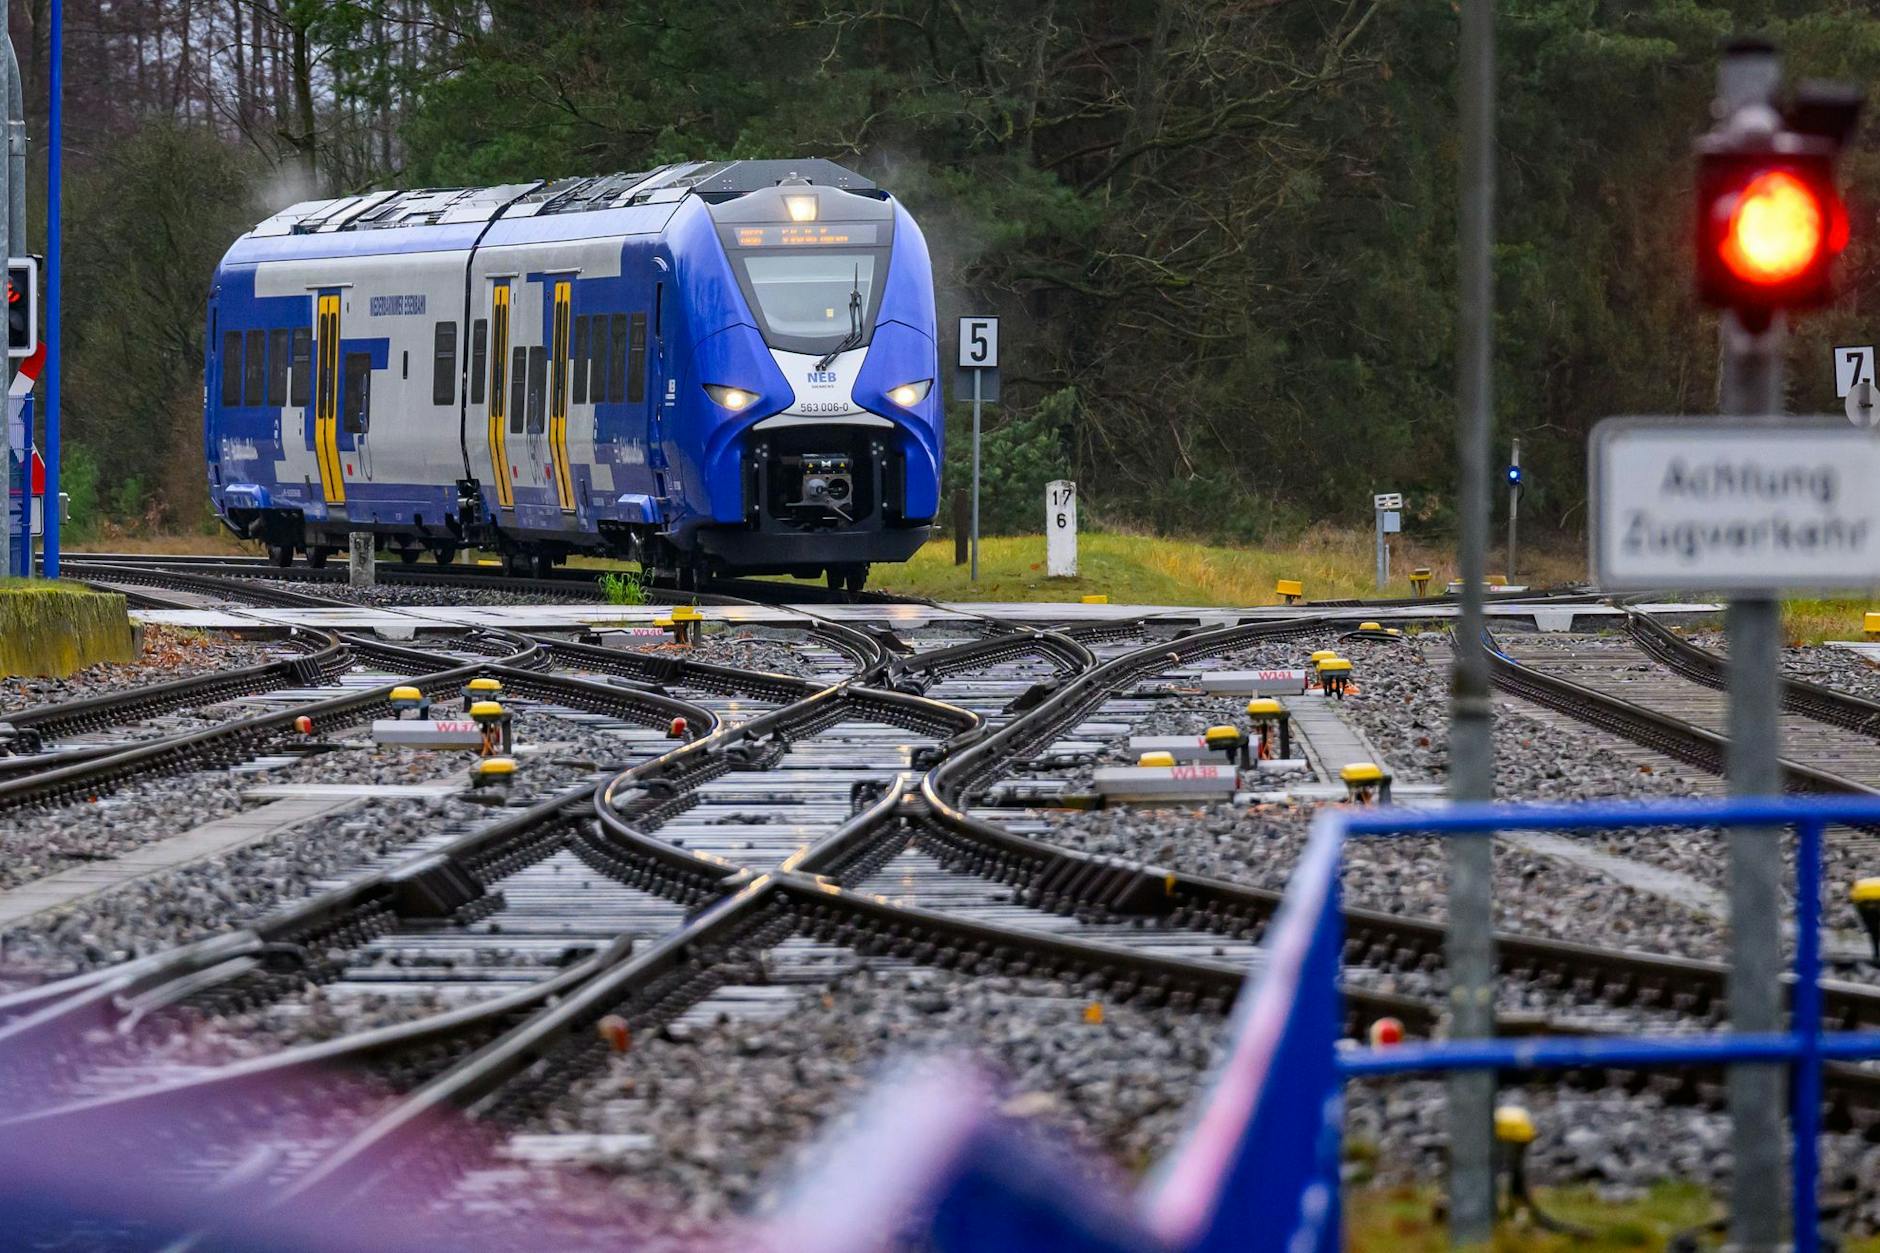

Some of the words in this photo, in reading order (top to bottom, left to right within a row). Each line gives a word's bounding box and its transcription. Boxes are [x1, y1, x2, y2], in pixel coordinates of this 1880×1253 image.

[971, 323, 987, 362] 5
[807, 372, 837, 383] NEB
[1846, 352, 1863, 388] 7
[800, 403, 819, 412] 563
[821, 402, 849, 412] 006-0
[1660, 458, 1838, 506] Achtung
[1053, 489, 1072, 505] 17
[1057, 513, 1067, 528] 6
[1622, 509, 1869, 560] Zugverkehr
[1172, 765, 1218, 779] W138
